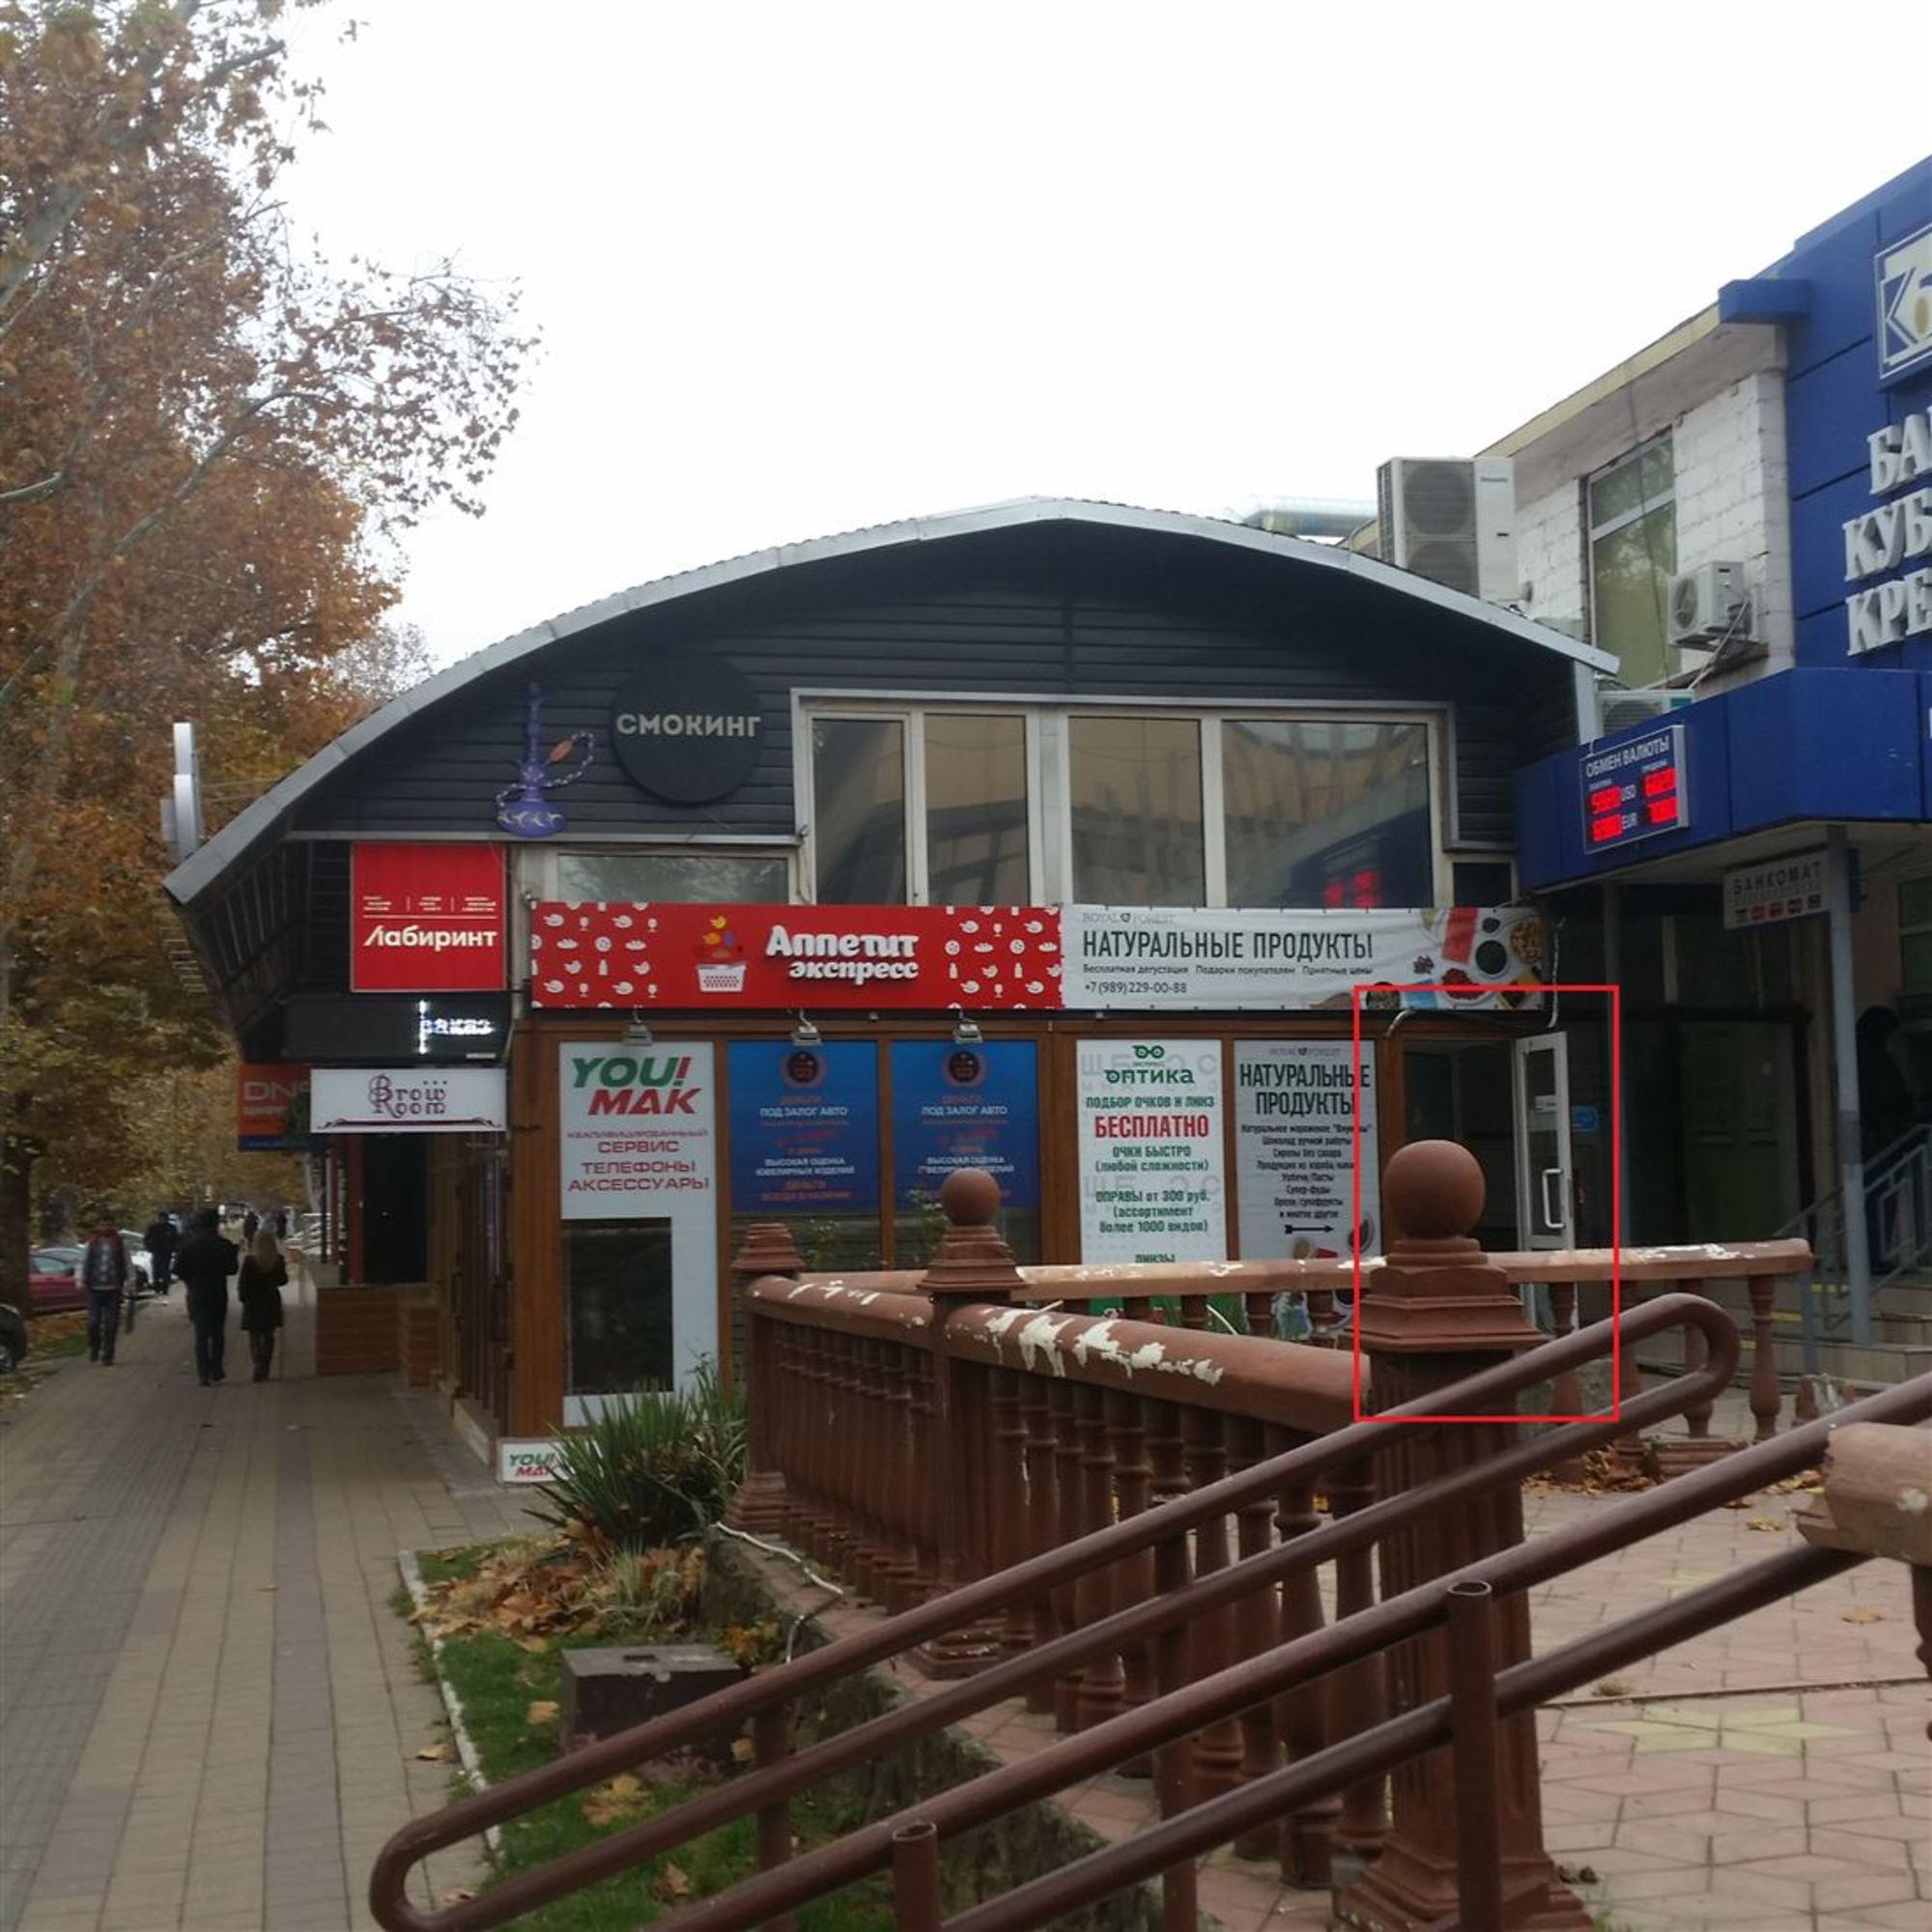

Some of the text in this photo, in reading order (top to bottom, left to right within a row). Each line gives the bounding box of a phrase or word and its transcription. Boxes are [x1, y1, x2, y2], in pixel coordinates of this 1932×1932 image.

[1867, 407, 1932, 496] БА
[616, 713, 761, 737] СМОКИНГ
[1585, 753, 1622, 778] ОБМЕН
[1624, 735, 1669, 765] ВАЛЮТЫ
[1733, 862, 1822, 895] БАНКОМАТ
[363, 924, 497, 952] Лабиринт
[765, 924, 920, 957] Аппетит
[1083, 930, 1373, 963] НАТУРАЛЬНЫЕ ПРОДУКТЫ
[789, 961, 919, 985] экспресс
[1083, 964, 1136, 974] Бесплатная
[1138, 965, 1188, 976] дегустация
[1196, 965, 1236, 976] Подарки
[572, 1057, 692, 1088] YOU!
[1086, 1096, 1132, 1109] ПОДБОР
[1135, 1096, 1172, 1108] ОЧКОВ
[1185, 1096, 1214, 1108] ЛИНЗ
[1256, 1092, 1355, 1117] ПРОДУКТЫ
[759, 1107, 783, 1118] ПОД
[820, 1106, 847, 1117] АВТО
[922, 1106, 944, 1117] ПОД
[980, 1105, 1009, 1116] АВТО
[1094, 1115, 1209, 1139] БЕСПЛАТНО
[598, 1141, 679, 1154] СЕРВИС
[1113, 1146, 1192, 1158] ОЧКИ БЫСТРО
[582, 1160, 696, 1175] ТЕЛЕФОНЫ
[1095, 1159, 1209, 1173] (любой сложности)
[568, 1178, 709, 1192] АКСЕССУАРЫ
[1095, 1190, 1144, 1203] ОПРАВЫ
[1146, 1193, 1158, 1203] от
[1187, 1190, 1210, 1205] руб.
[1113, 1206, 1193, 1219] (ассортимент
[1099, 1220, 1208, 1234] более 1000 видов)
